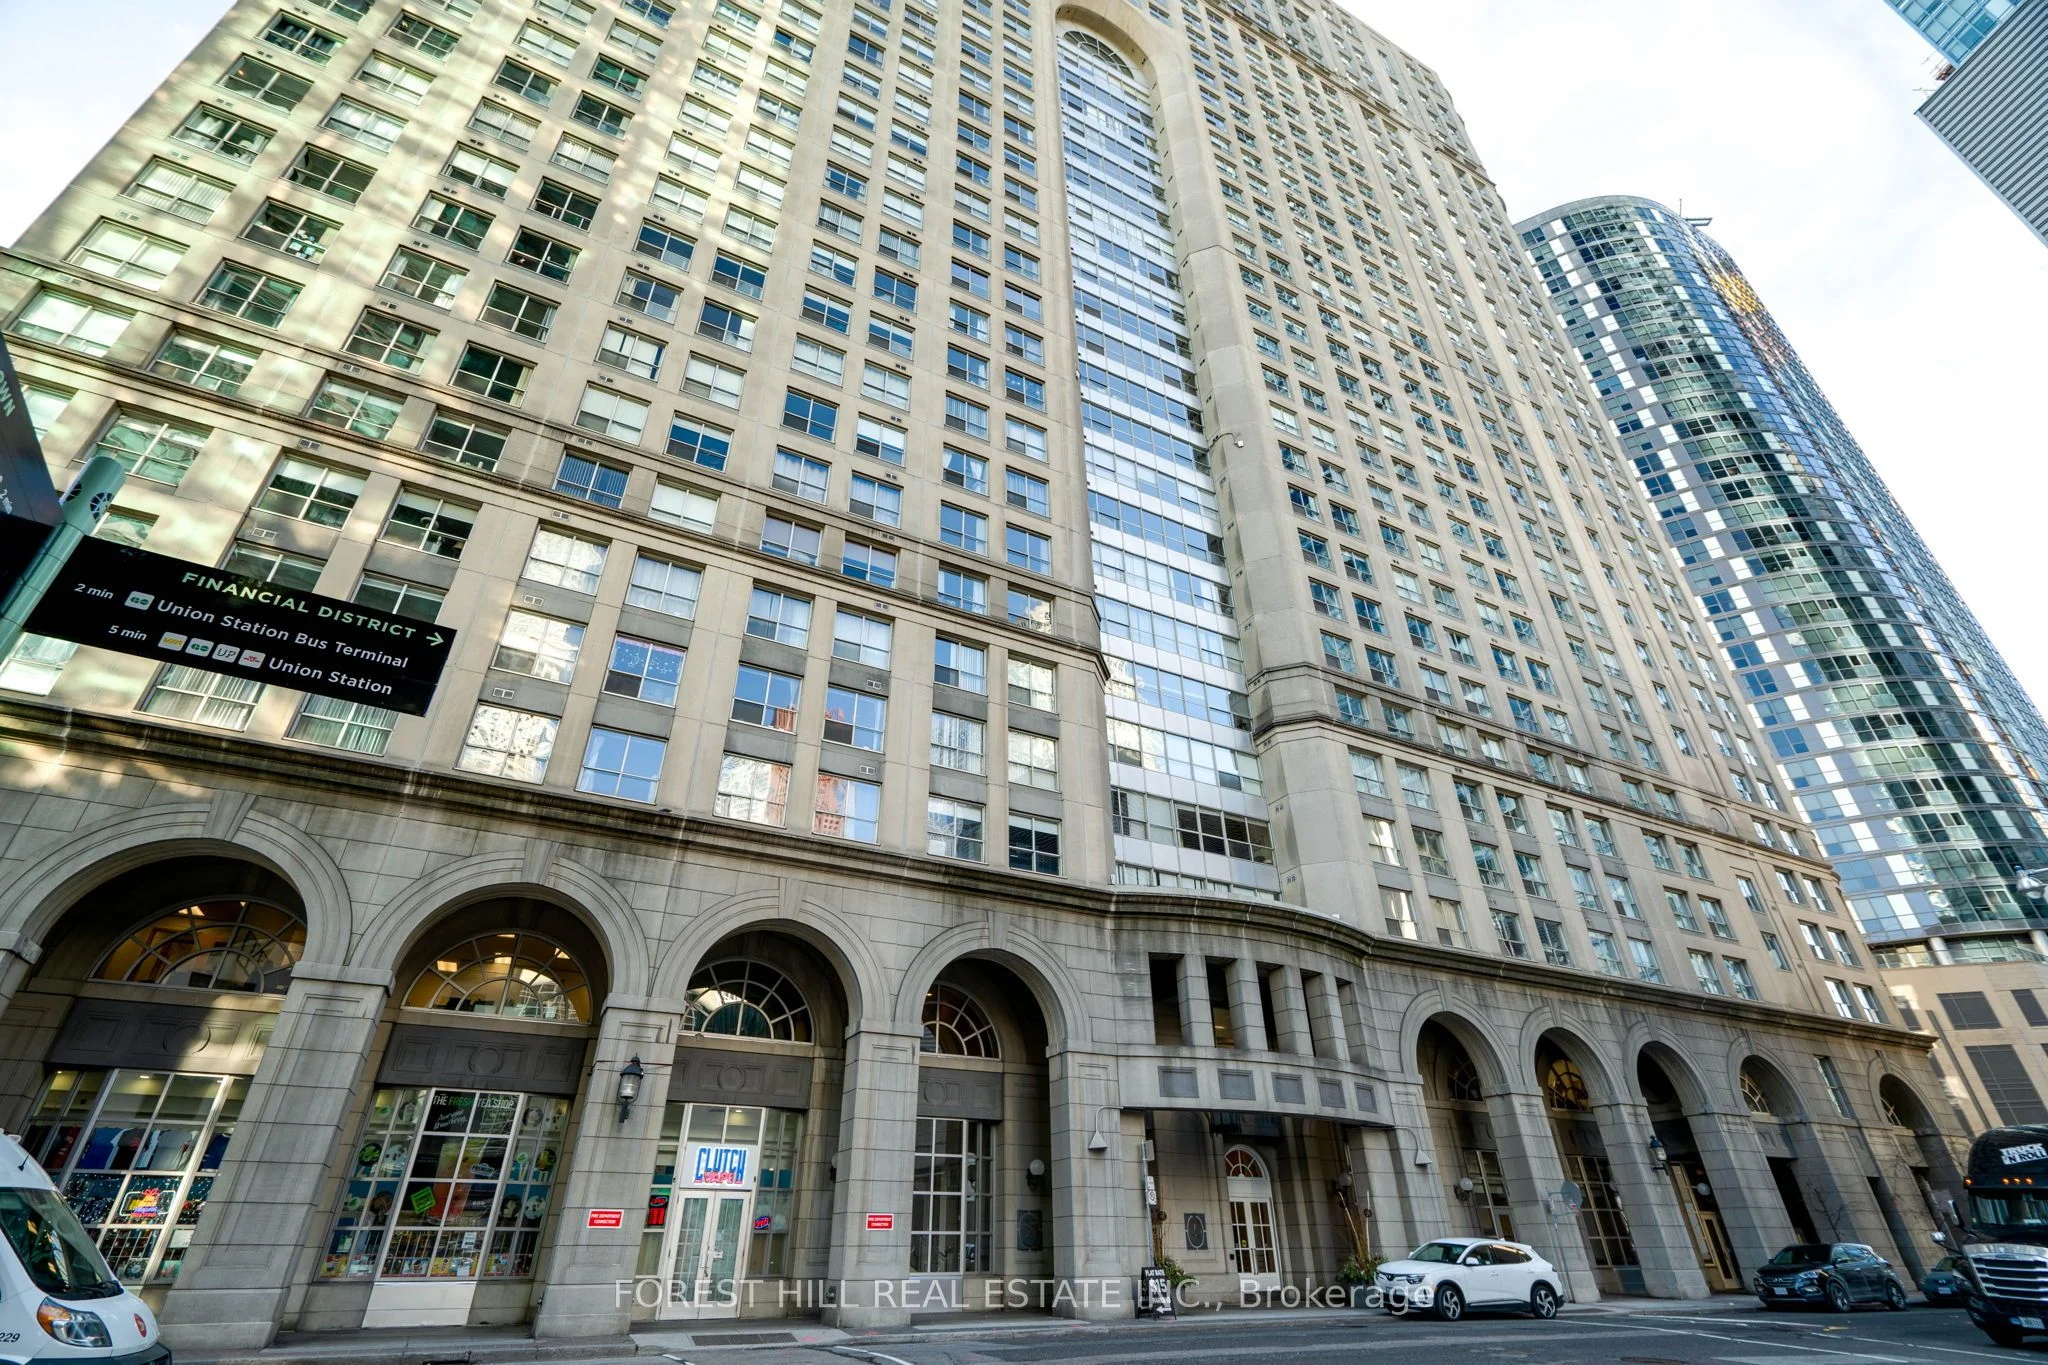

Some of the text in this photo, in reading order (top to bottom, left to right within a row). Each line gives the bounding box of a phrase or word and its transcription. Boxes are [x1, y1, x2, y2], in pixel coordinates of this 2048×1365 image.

[181, 572, 416, 639] FINANCIAL DISTRICT
[74, 583, 84, 593] 2
[87, 588, 114, 600] min
[157, 600, 215, 623] Union
[220, 615, 289, 641] Station
[294, 632, 328, 650] Bus
[335, 641, 409, 668] Terminal
[108, 625, 119, 634] 5
[121, 629, 147, 641] min
[217, 648, 236, 658] UP
[268, 657, 322, 680] Union
[328, 671, 393, 695] Station
[433, 1095, 448, 1106] THE
[448, 1096, 476, 1108] FRESH
[492, 1098, 515, 1109] SHOP
[694, 1147, 747, 1183] CLUTCH
[704, 1171, 734, 1184] VAPE
[0, 1332, 20, 1343] 229
